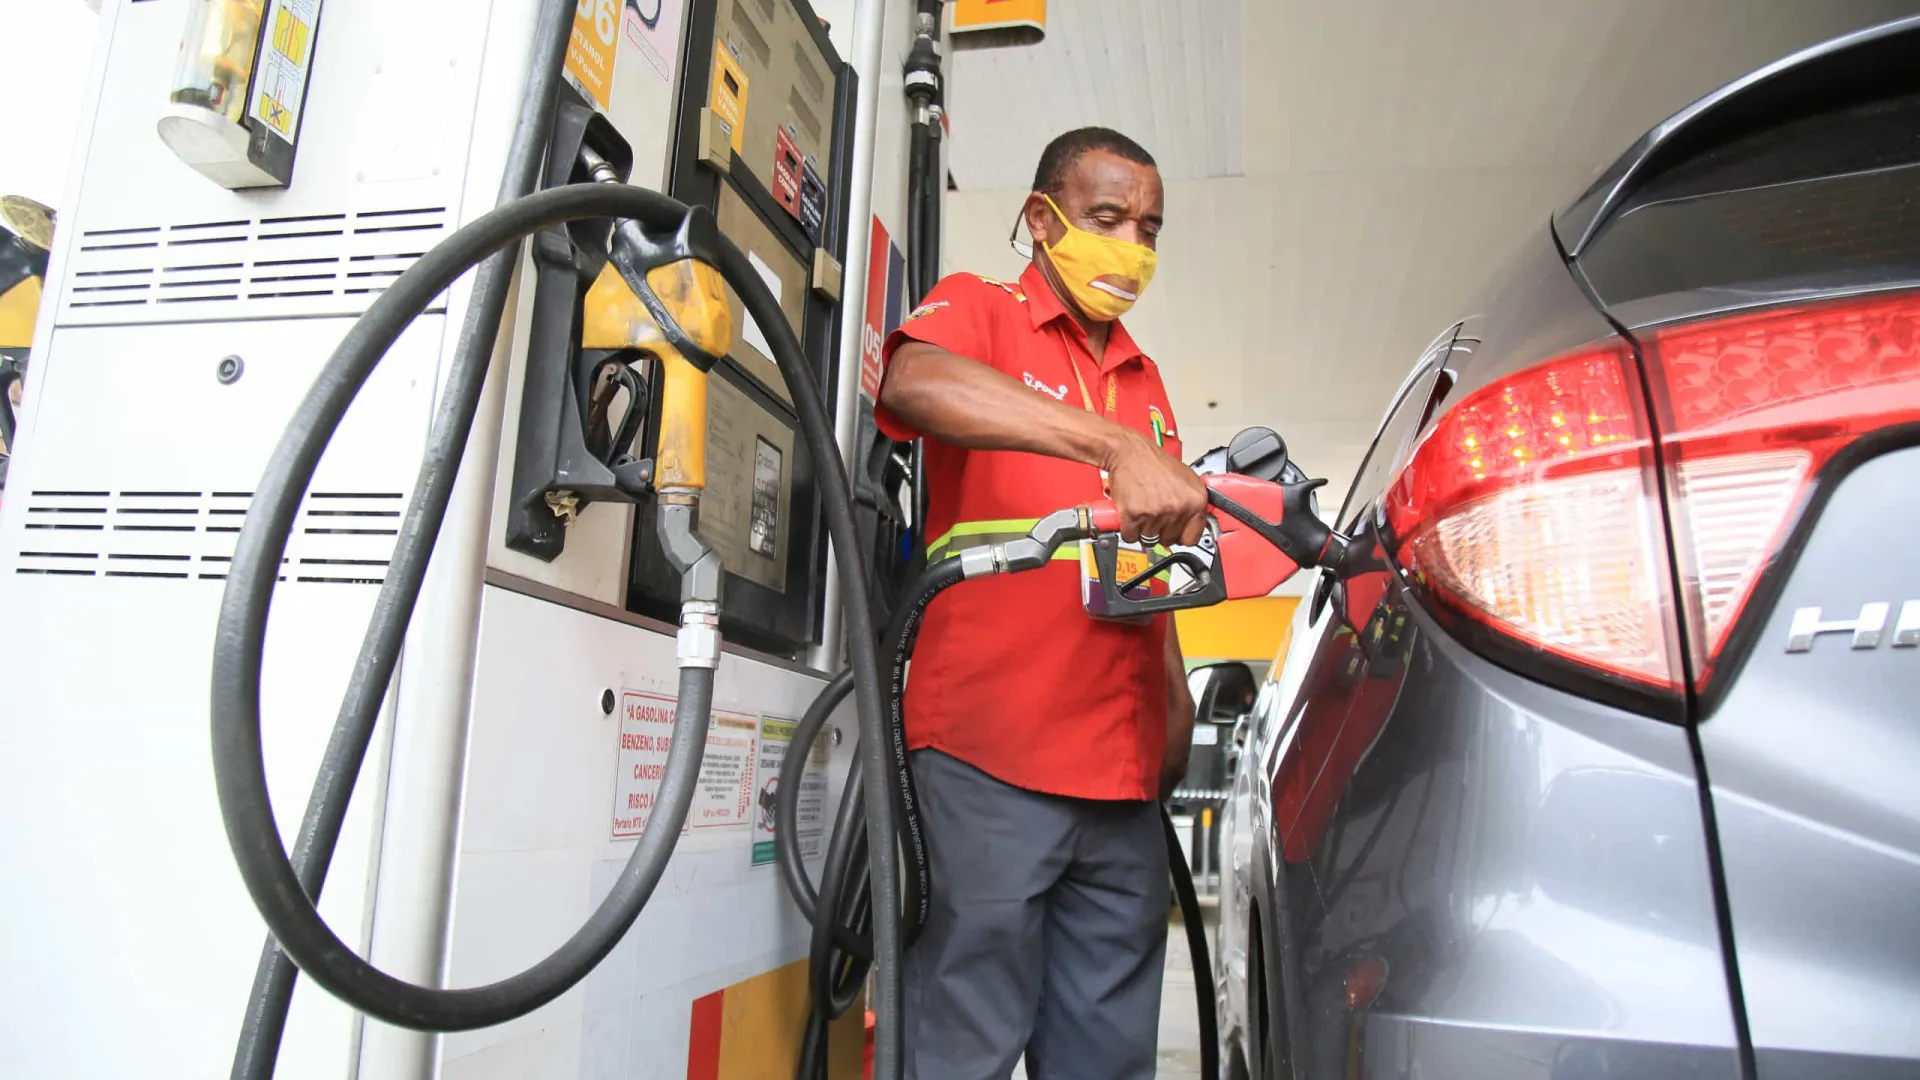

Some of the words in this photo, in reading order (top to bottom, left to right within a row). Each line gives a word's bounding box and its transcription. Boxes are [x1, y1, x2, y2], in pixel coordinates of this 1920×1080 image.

[571, 26, 605, 71] ETANOL
[571, 46, 602, 88] V-Power
[865, 323, 880, 363] 05
[636, 705, 668, 724] GASOLINA
[622, 733, 655, 755] BENZENO,
[628, 793, 649, 809] RISCO
[615, 818, 632, 829] Portaria
